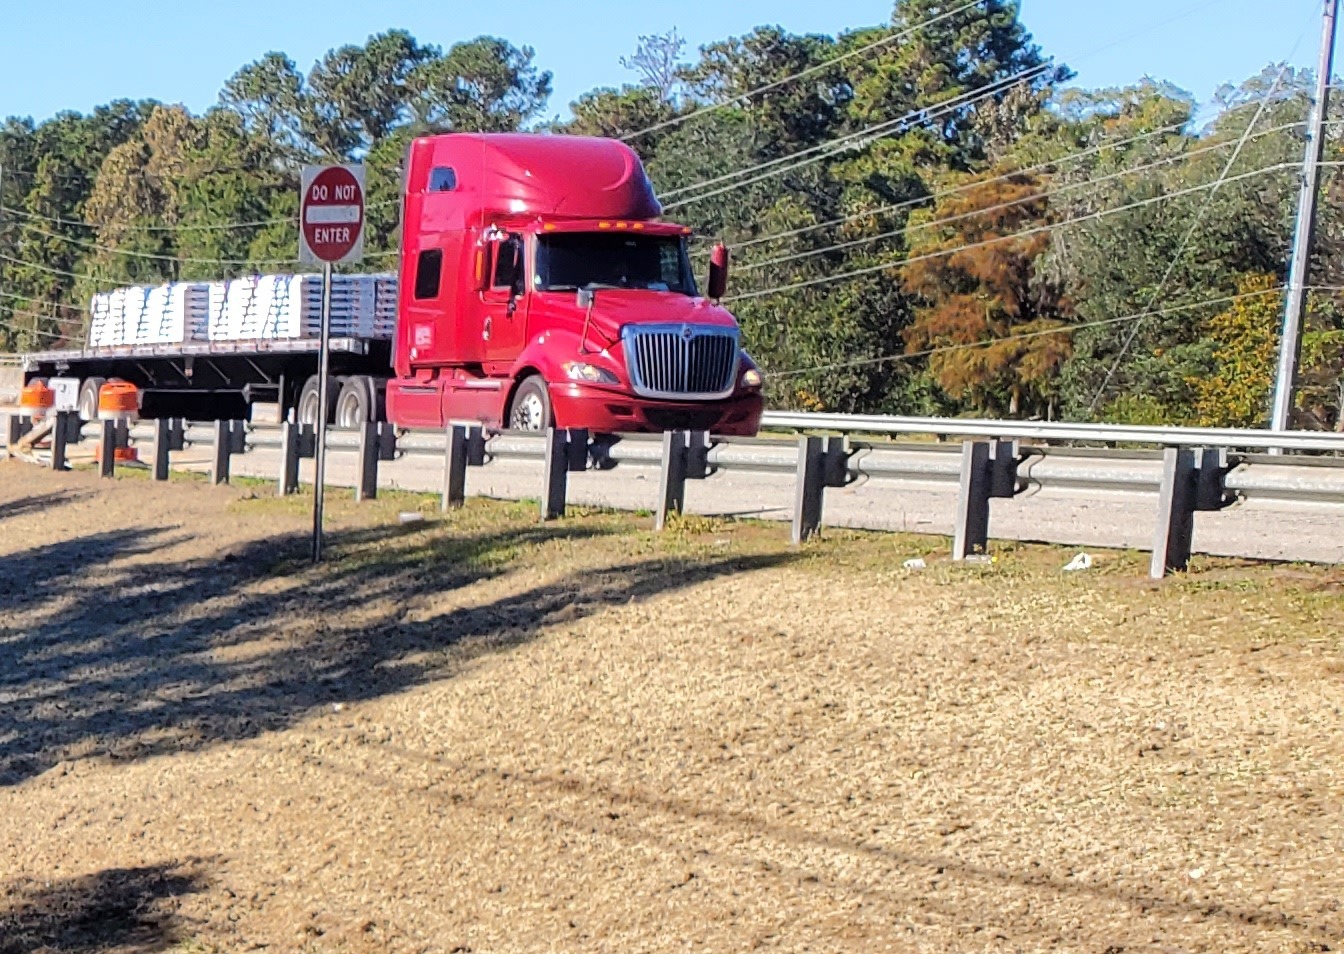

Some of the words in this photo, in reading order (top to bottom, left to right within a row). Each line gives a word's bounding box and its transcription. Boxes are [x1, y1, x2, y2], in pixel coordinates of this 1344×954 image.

[312, 185, 328, 201] DO
[335, 185, 356, 201] NOT
[314, 227, 350, 244] ENTER
